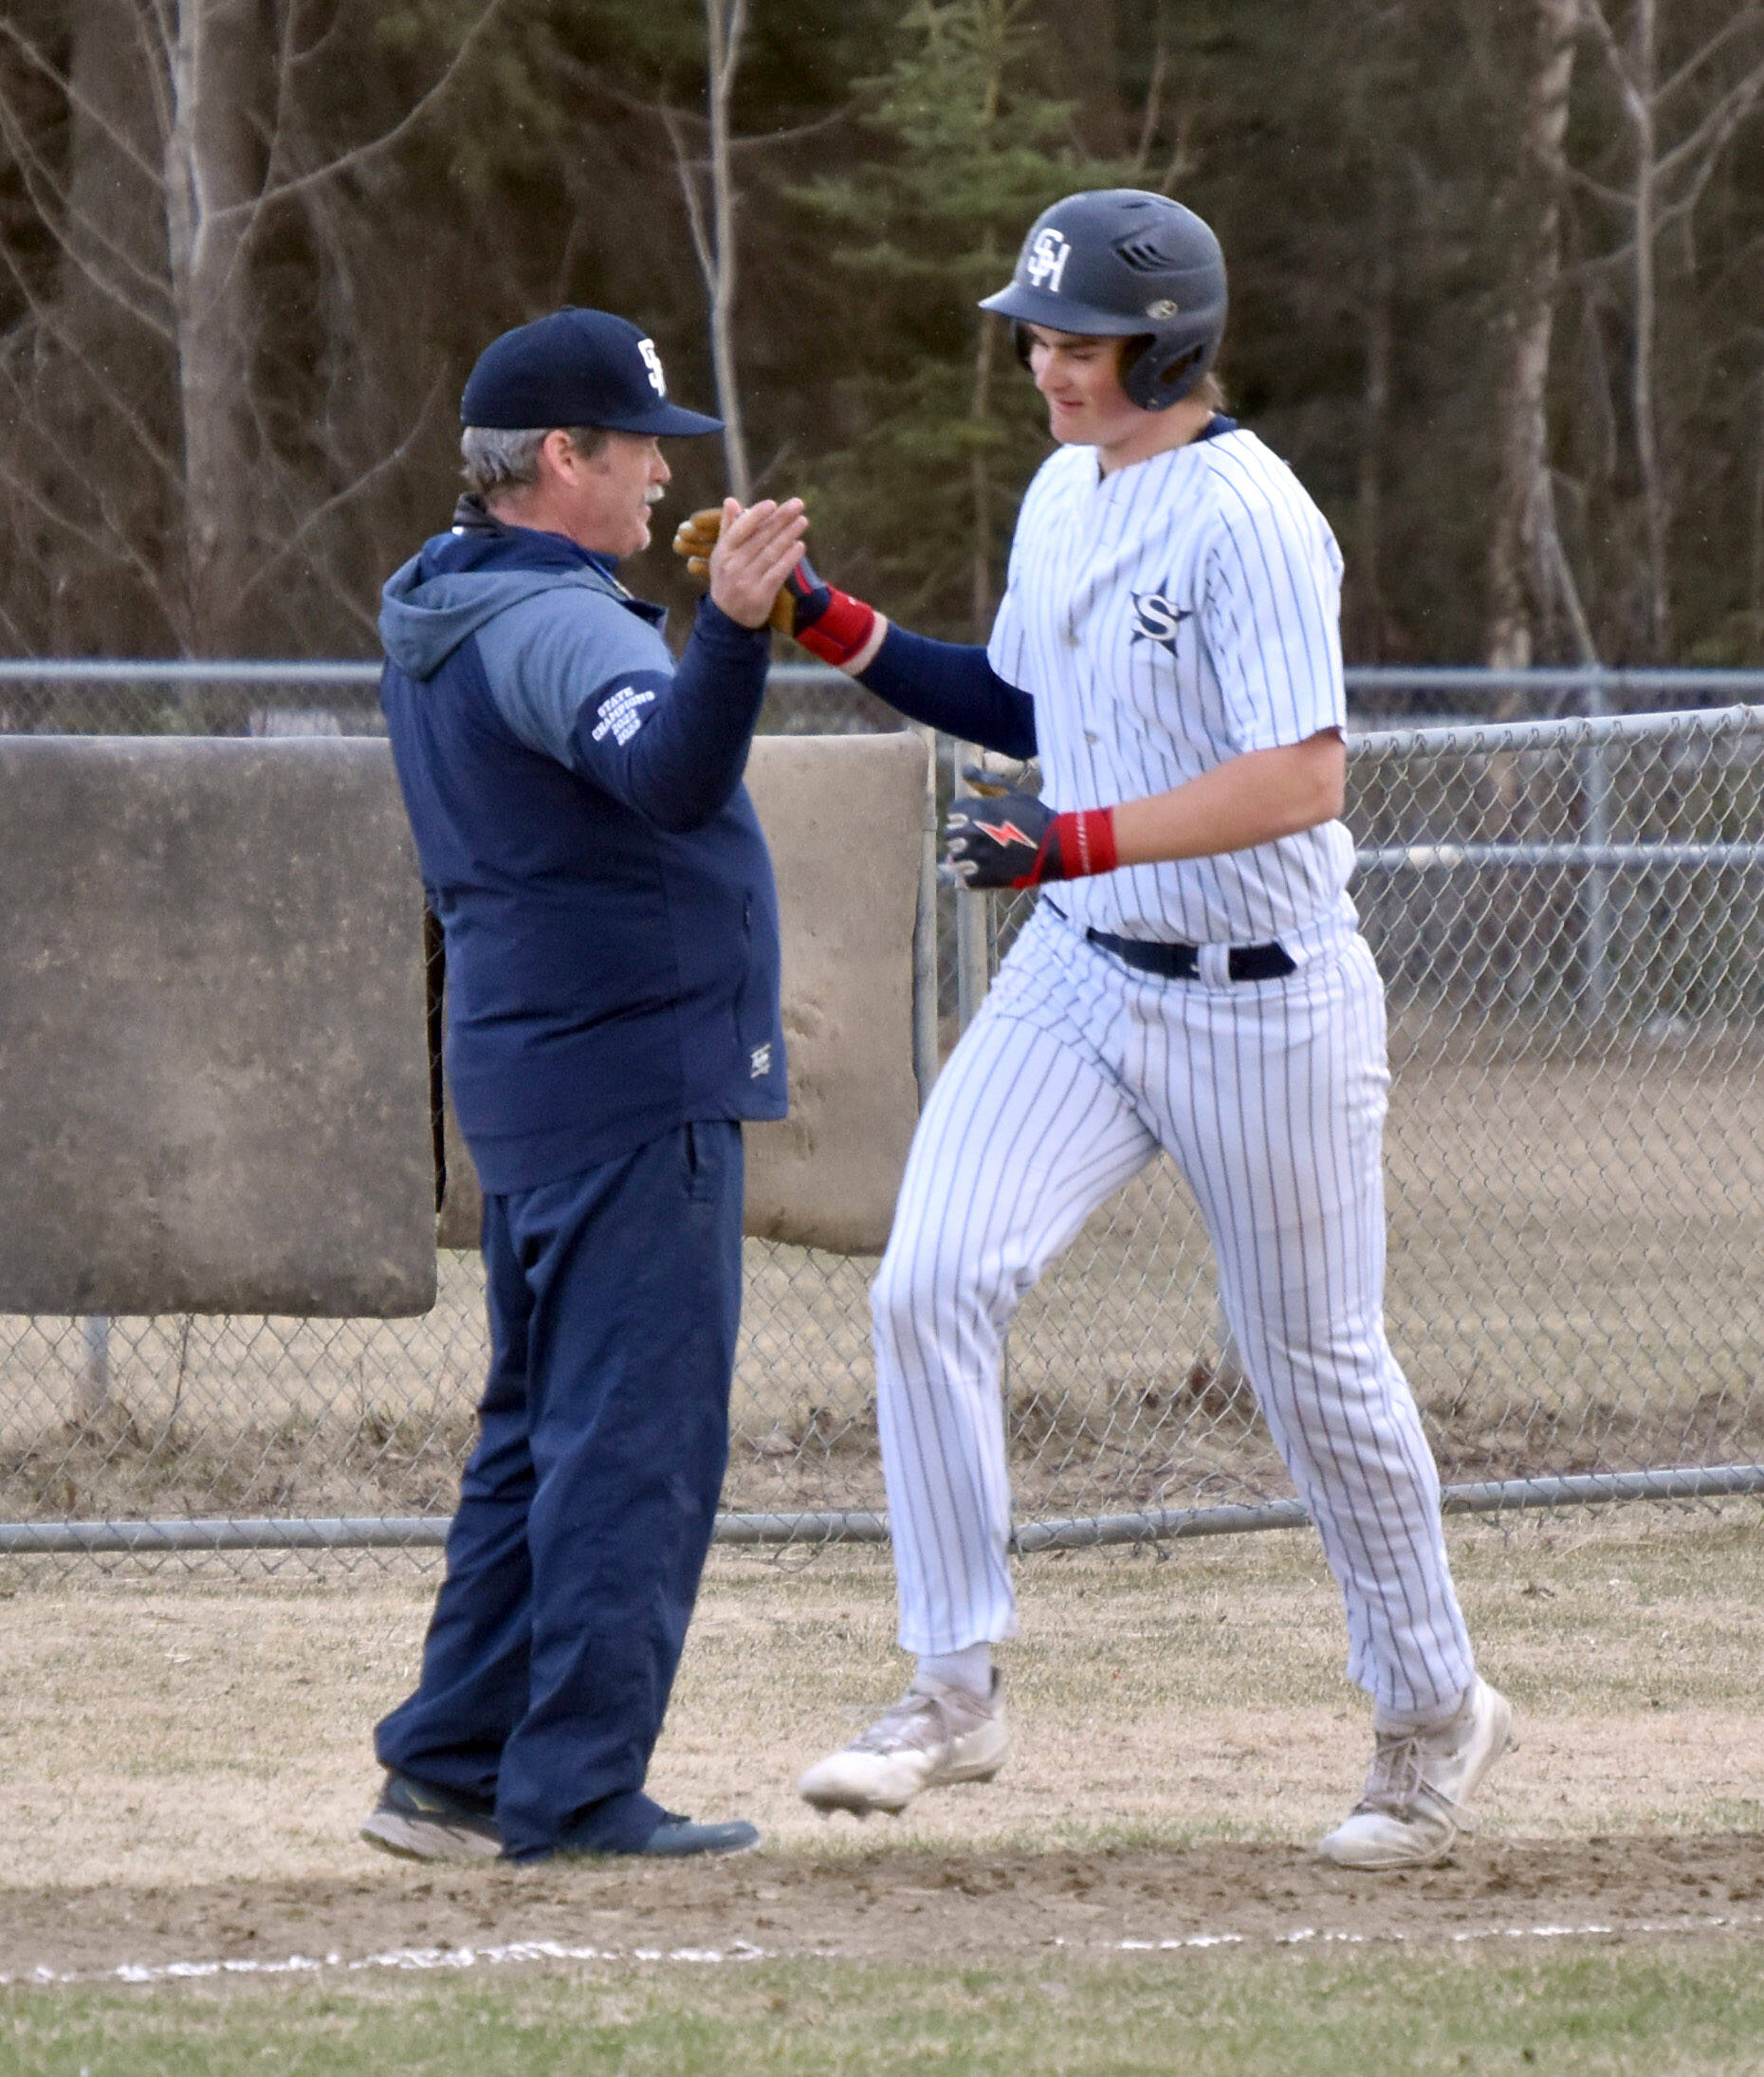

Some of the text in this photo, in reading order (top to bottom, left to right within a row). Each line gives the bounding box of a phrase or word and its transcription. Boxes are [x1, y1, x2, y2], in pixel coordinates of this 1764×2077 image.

[1027, 228, 1072, 293] SH
[1133, 594, 1178, 640] S
[592, 690, 654, 741] CHAMPIONS
[597, 687, 633, 717] STATE
